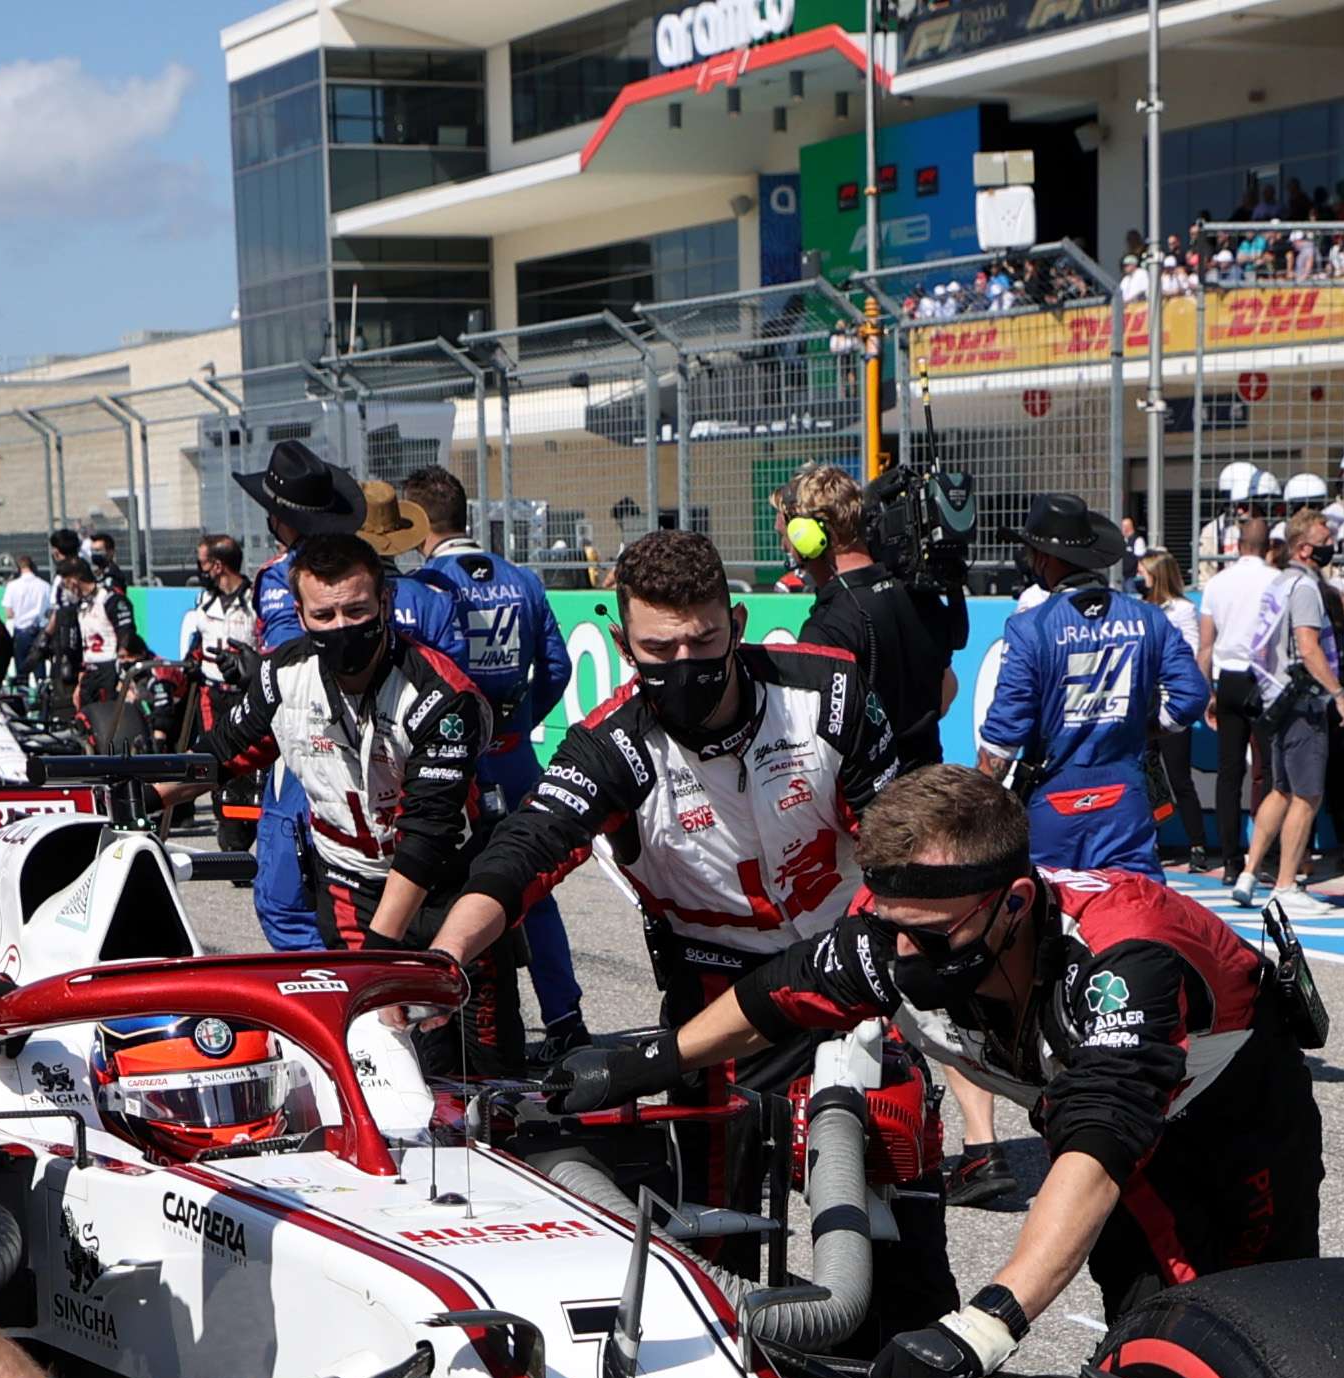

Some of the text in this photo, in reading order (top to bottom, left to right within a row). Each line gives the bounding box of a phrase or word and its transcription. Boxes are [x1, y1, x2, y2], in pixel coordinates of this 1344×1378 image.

[656, 0, 795, 68] aramco
[1227, 288, 1325, 337] DHL
[1057, 620, 1146, 645] URALKALI
[408, 690, 443, 731] sparco
[828, 673, 847, 735] sparco
[610, 728, 650, 786] sparco
[545, 764, 598, 797] zadara
[682, 814, 716, 831] ONE
[283, 982, 344, 994] ORLEN
[1095, 1010, 1146, 1031] ADLER
[128, 1077, 168, 1087] CARRERA
[205, 1070, 246, 1082] SINGHA
[30, 1093, 91, 1106] SINGHA
[162, 1191, 246, 1256] CARRERA
[397, 1220, 593, 1242] HUSKI
[417, 1230, 605, 1248] CHOCOLATE
[53, 1293, 118, 1340] SINGHA
